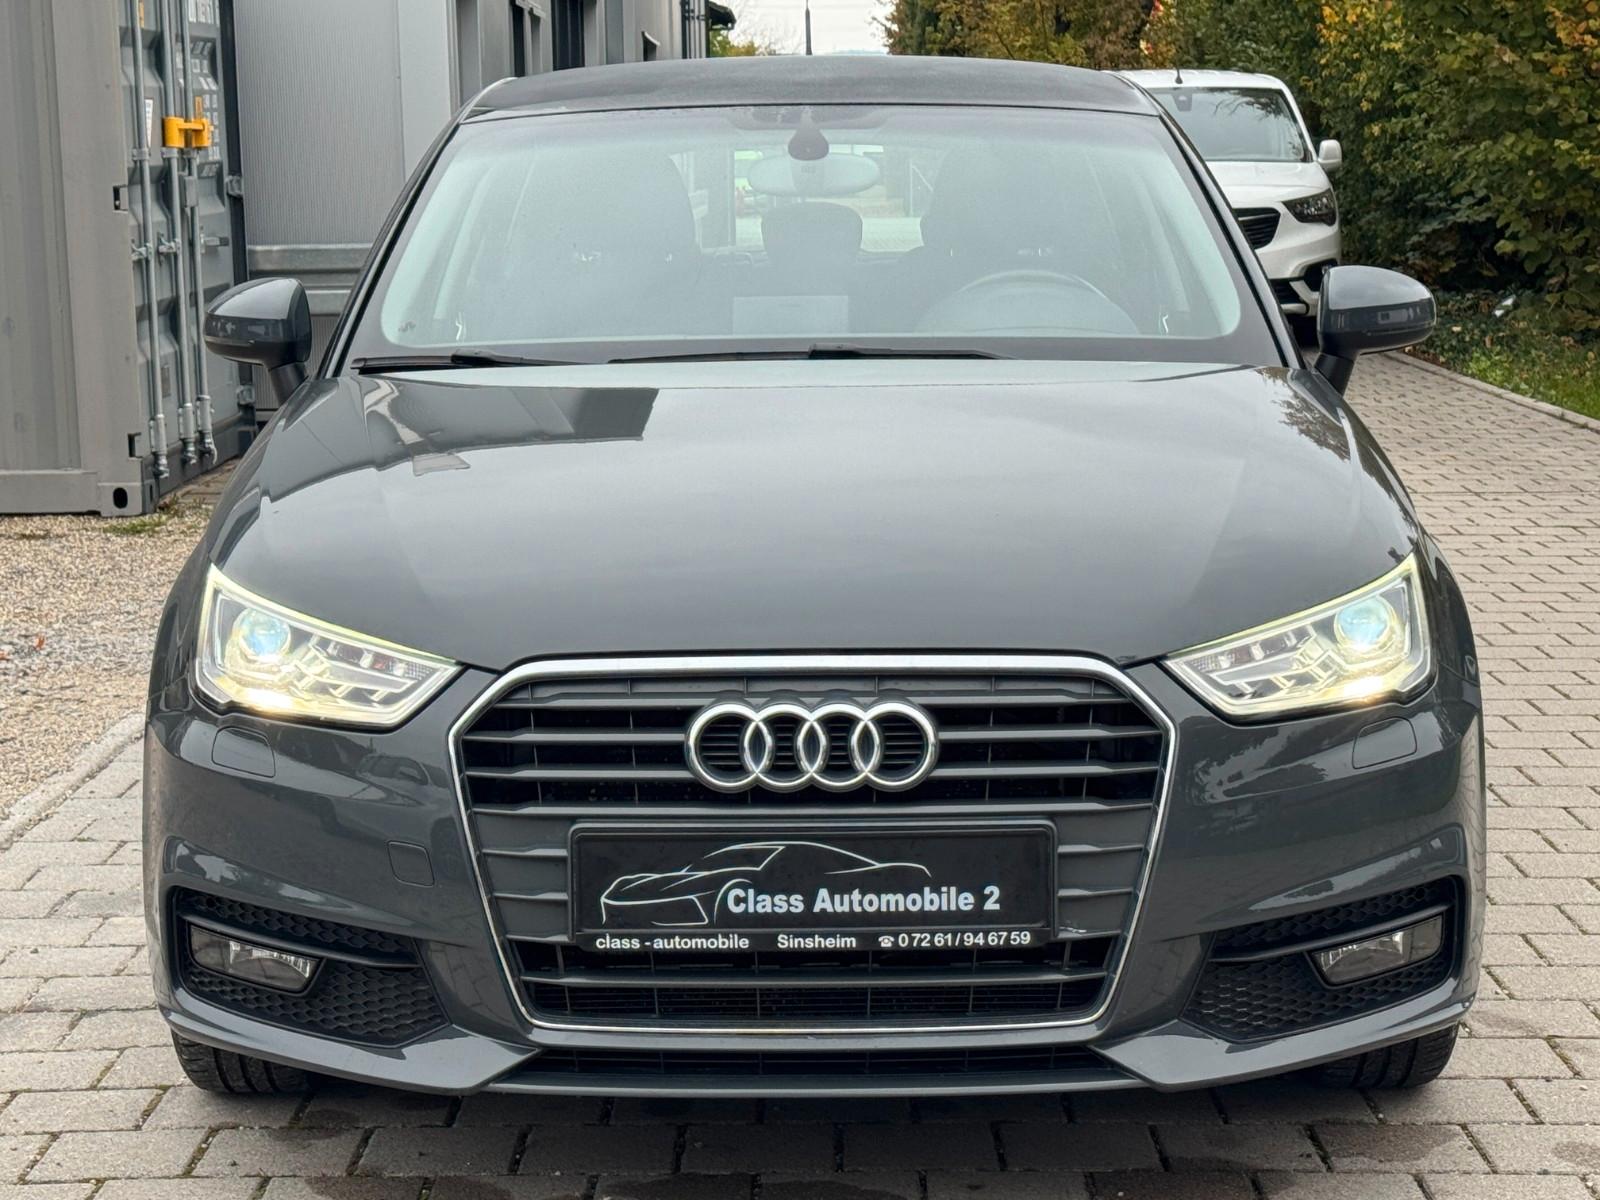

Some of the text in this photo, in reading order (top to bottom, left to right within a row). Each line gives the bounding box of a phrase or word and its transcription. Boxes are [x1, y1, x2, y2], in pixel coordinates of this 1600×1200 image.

[727, 885, 1001, 914] Class Automobile 2
[595, 933, 641, 950] class
[777, 933, 857, 949] Sinsheim
